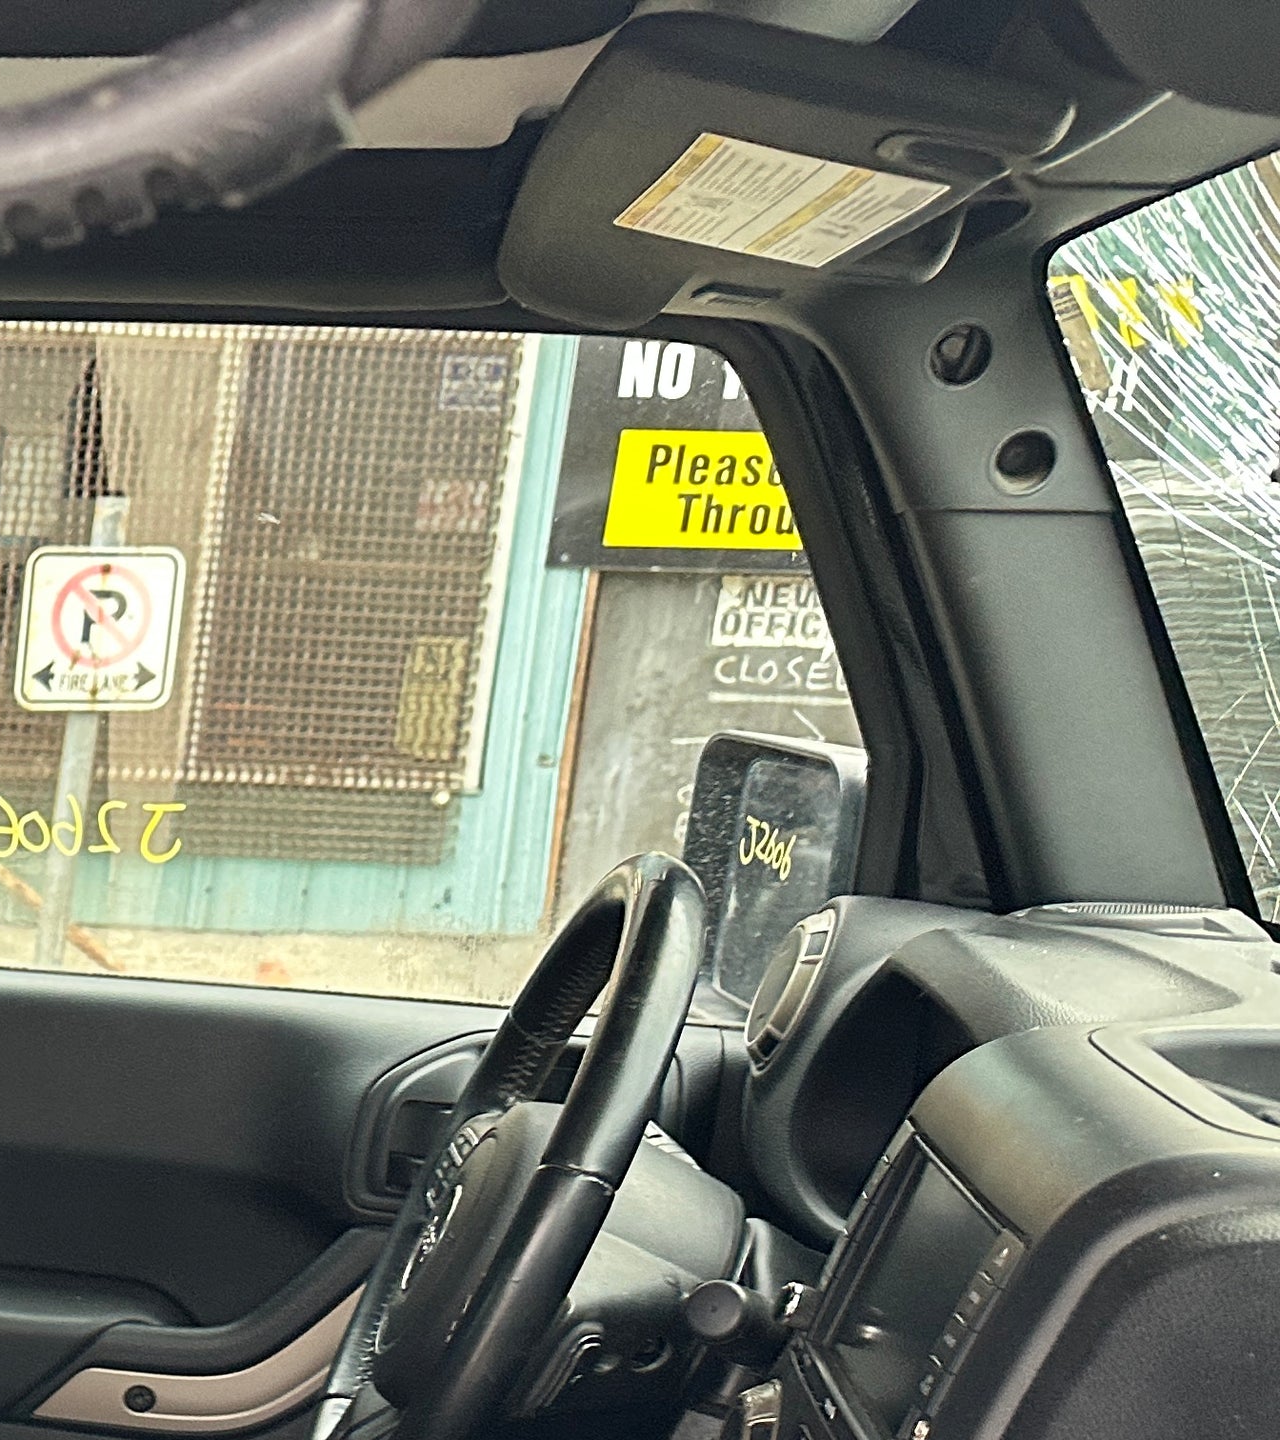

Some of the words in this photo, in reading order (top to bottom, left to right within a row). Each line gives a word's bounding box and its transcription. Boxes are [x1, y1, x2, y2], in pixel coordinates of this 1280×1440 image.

[617, 340, 697, 400] NO
[719, 607, 824, 639] OFFIC
[739, 814, 797, 881] J2606
